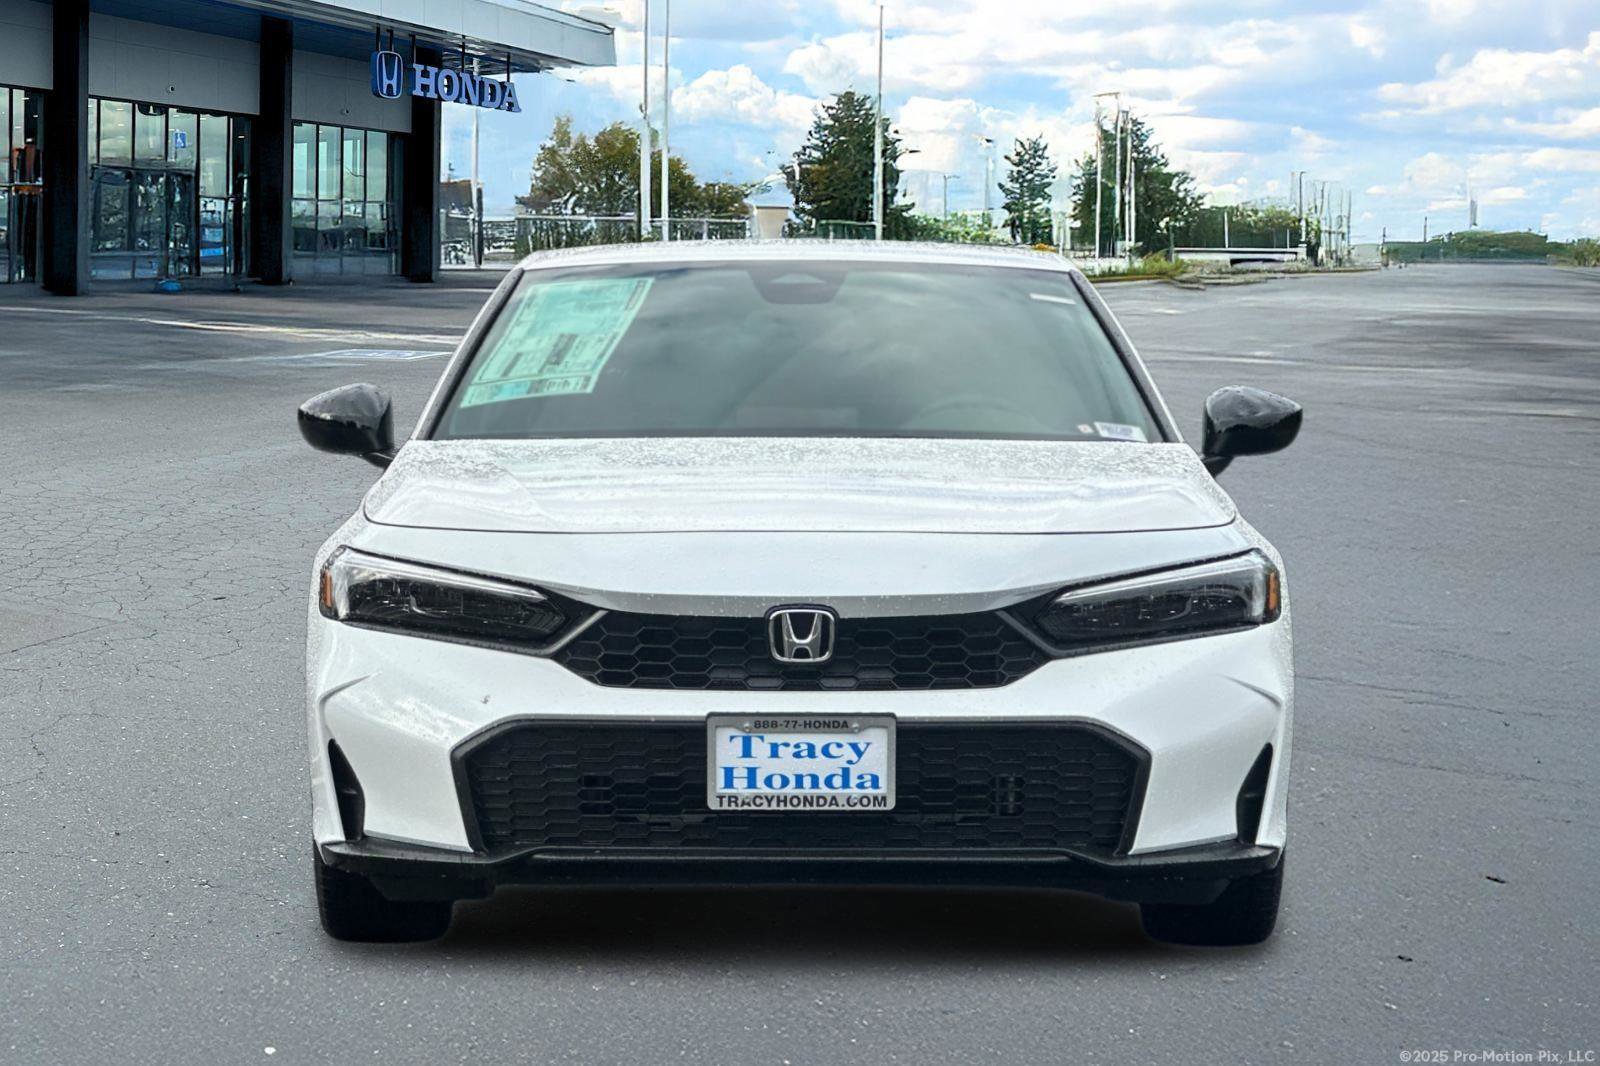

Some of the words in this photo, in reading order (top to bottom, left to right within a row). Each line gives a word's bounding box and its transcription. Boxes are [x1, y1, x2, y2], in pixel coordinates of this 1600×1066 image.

[412, 63, 522, 113] HONDA
[753, 720, 849, 729] 888-77-HONDA
[729, 735, 872, 765] Tracy
[720, 766, 882, 790] Honda
[716, 795, 887, 808] TRACYHONDA.COM
